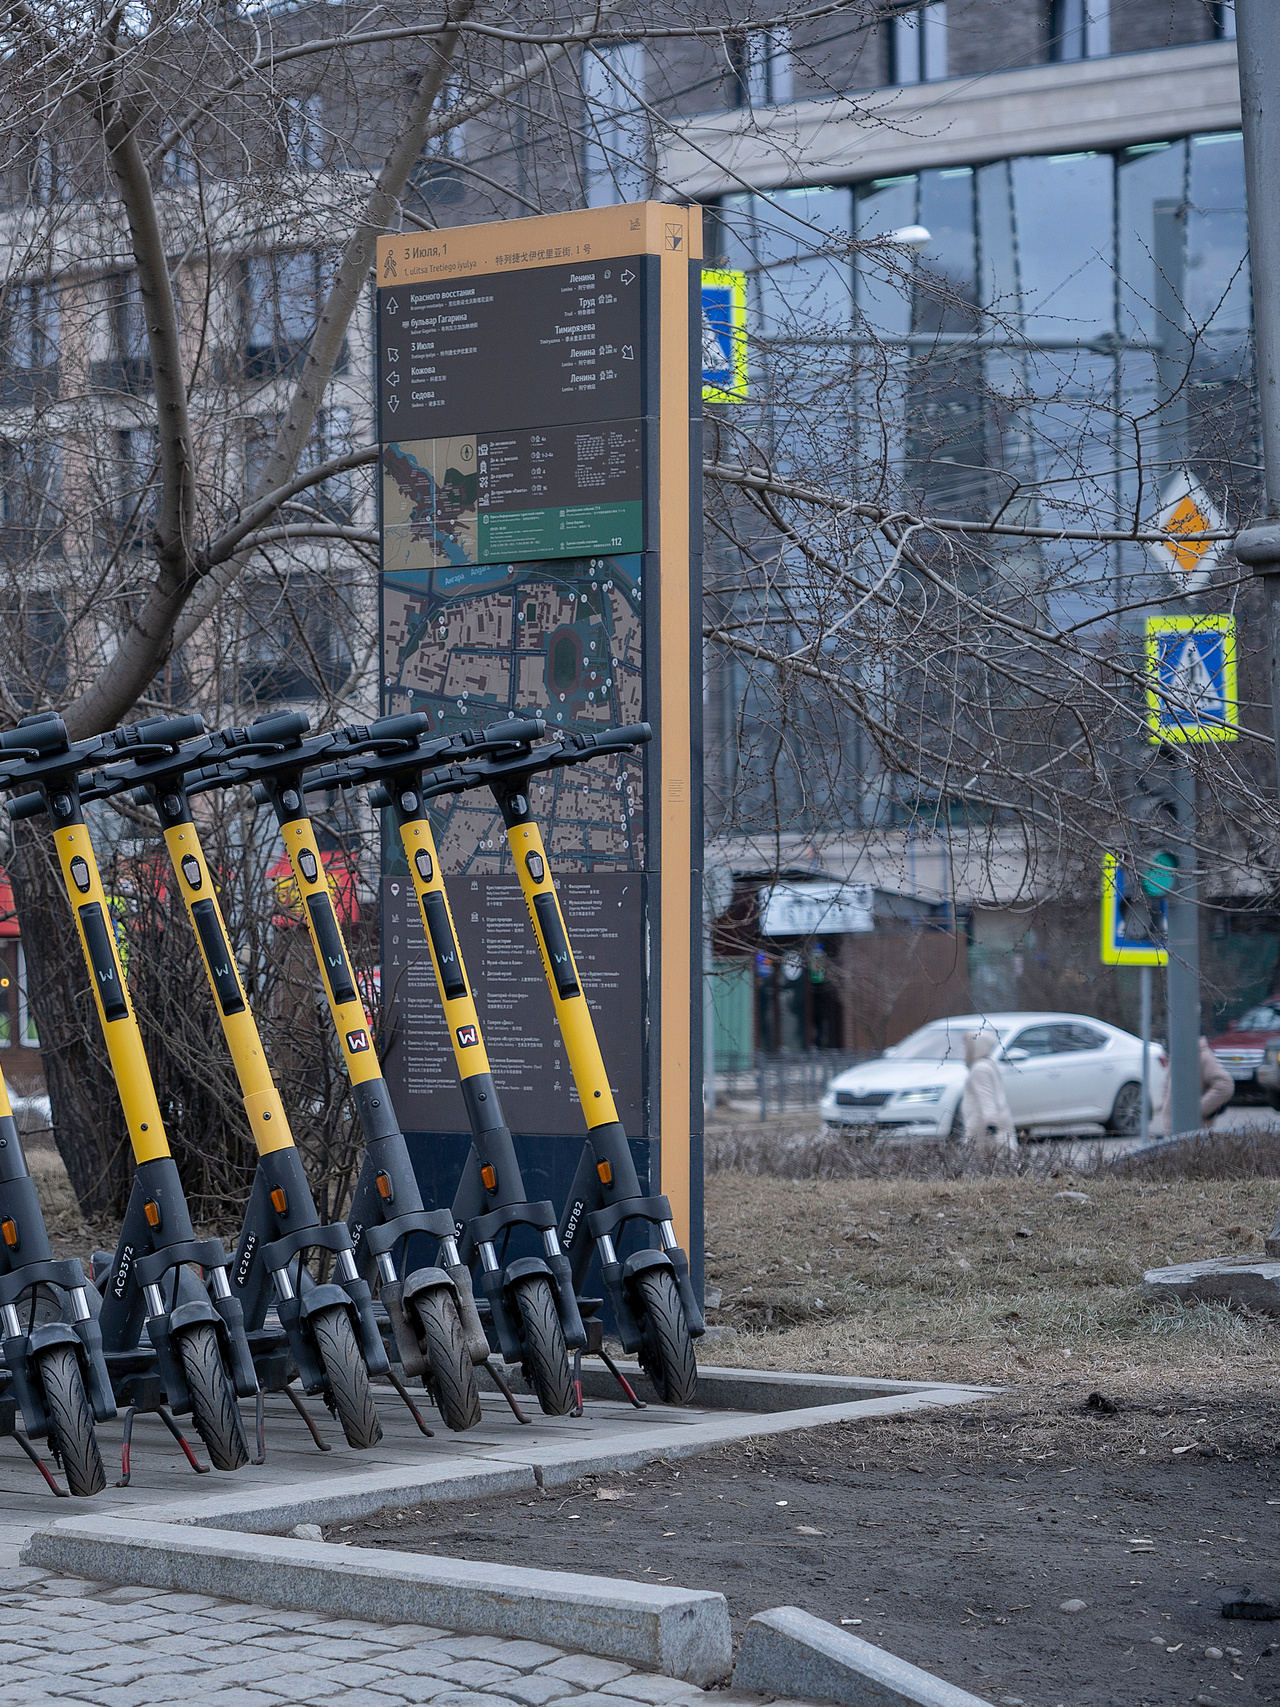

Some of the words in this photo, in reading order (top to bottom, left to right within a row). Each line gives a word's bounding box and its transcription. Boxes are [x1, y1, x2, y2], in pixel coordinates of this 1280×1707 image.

[404, 248, 410, 260] 3
[412, 246, 440, 259] Июля,
[442, 243, 448, 255] 1
[410, 266, 428, 276] ulitsa
[429, 263, 456, 273] Tretiego
[457, 260, 477, 272] iyulya
[570, 273, 596, 283] Ленина
[410, 292, 440, 304] Красного
[441, 288, 475, 299] восстания
[579, 298, 596, 309] Труд
[410, 317, 437, 328] бульвар
[438, 314, 468, 324] Гагарина
[555, 323, 596, 334] Тимирязева
[411, 342, 416, 352] 3
[416, 342, 435, 350] Июля
[570, 348, 596, 358] Ленина
[411, 366, 436, 376] Кожова
[570, 374, 596, 383] Ленина
[411, 391, 435, 400] Седова
[611, 537, 622, 546] 112
[444, 574, 464, 585] Ангара
[562, 1200, 584, 1248] AB8782
[236, 1236, 256, 1285] AC2045
[114, 1246, 134, 1298] AC9372
